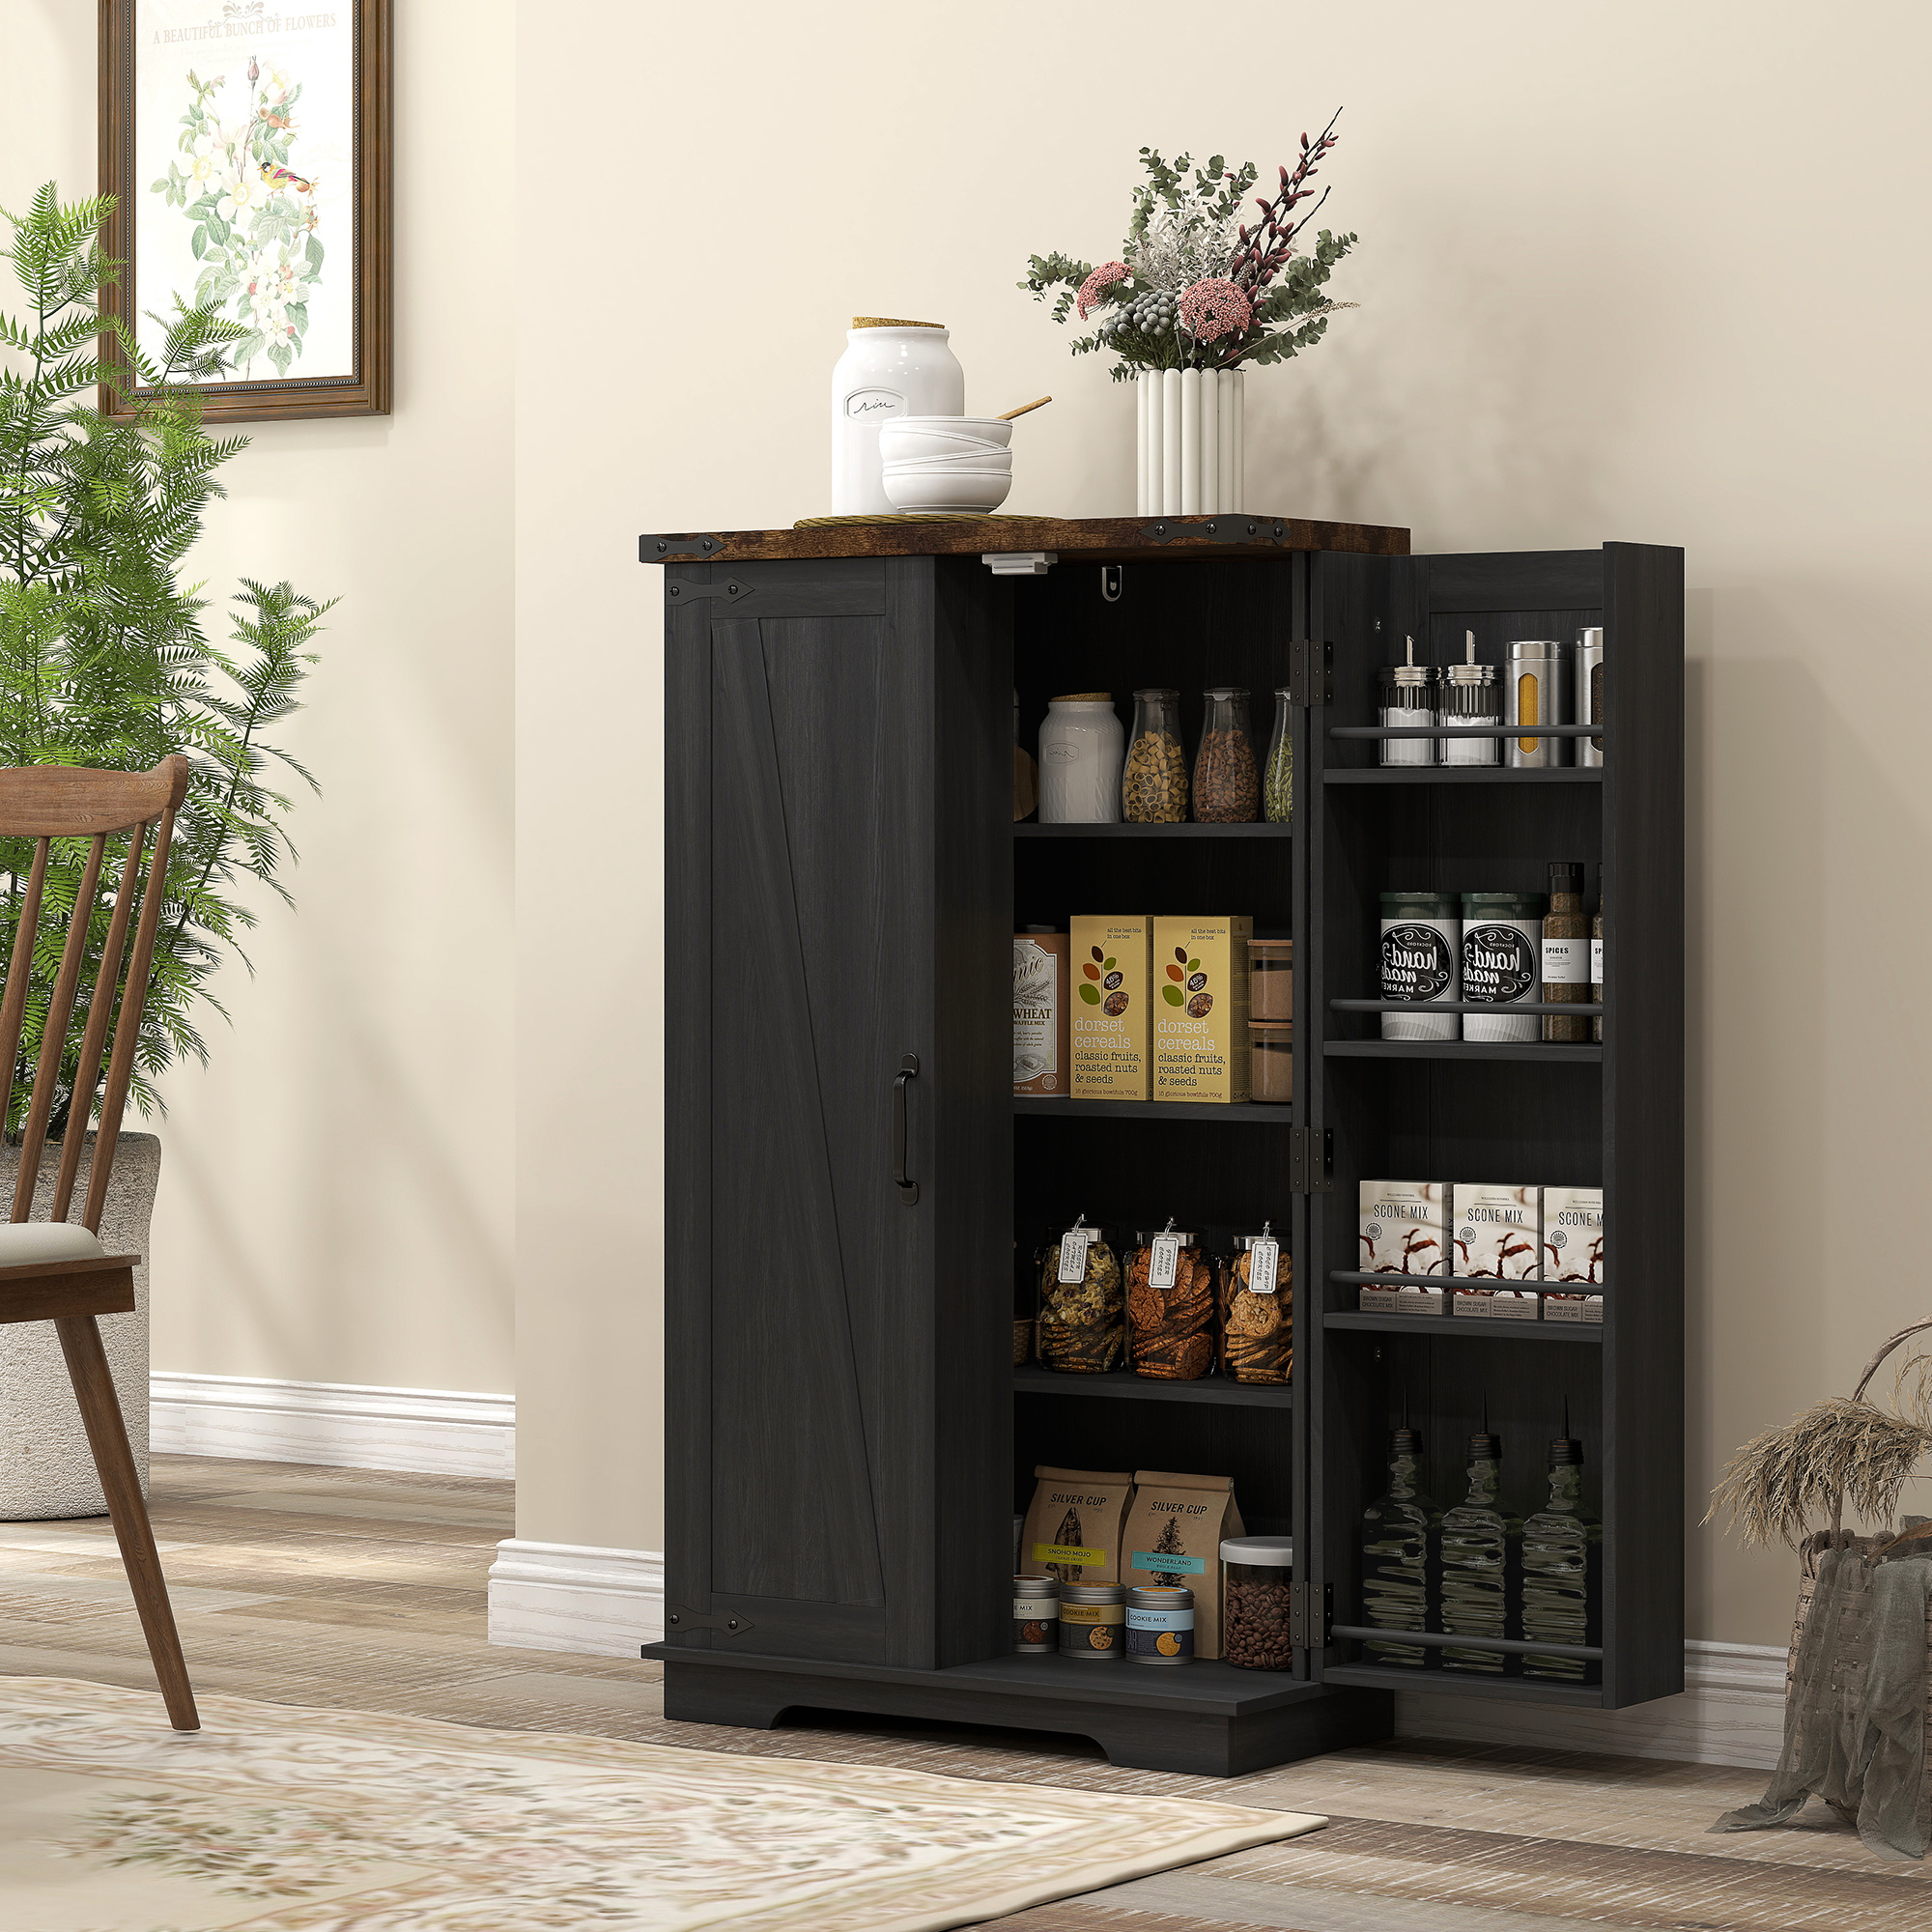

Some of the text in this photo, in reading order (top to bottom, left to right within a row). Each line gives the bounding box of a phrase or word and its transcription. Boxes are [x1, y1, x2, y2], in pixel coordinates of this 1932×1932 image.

[153, 13, 336, 44] A BEAUTIFUL BUNCH OF FLOWERS
[1075, 1017, 1125, 1032] dorset
[1158, 1019, 1209, 1034] dorset
[1075, 1035, 1131, 1048] cereals
[1158, 1036, 1215, 1051] cereals
[1075, 1051, 1141, 1062] classic fruits,
[1158, 1053, 1225, 1065] classic fruits,
[1075, 1063, 1138, 1073] roasted nuts
[1158, 1065, 1222, 1075] roasted nuts
[1075, 1073, 1113, 1083] & seeds
[1158, 1076, 1197, 1086] & seeds
[1374, 1204, 1428, 1219] SCONE MIX
[1468, 1208, 1523, 1223] SCONE MIX
[1559, 1211, 1592, 1226] SCONE
[1051, 1493, 1107, 1506] SILVER CUP
[1151, 1501, 1207, 1515] SILVER CUP
[1146, 1557, 1192, 1566] WONDERLAND
